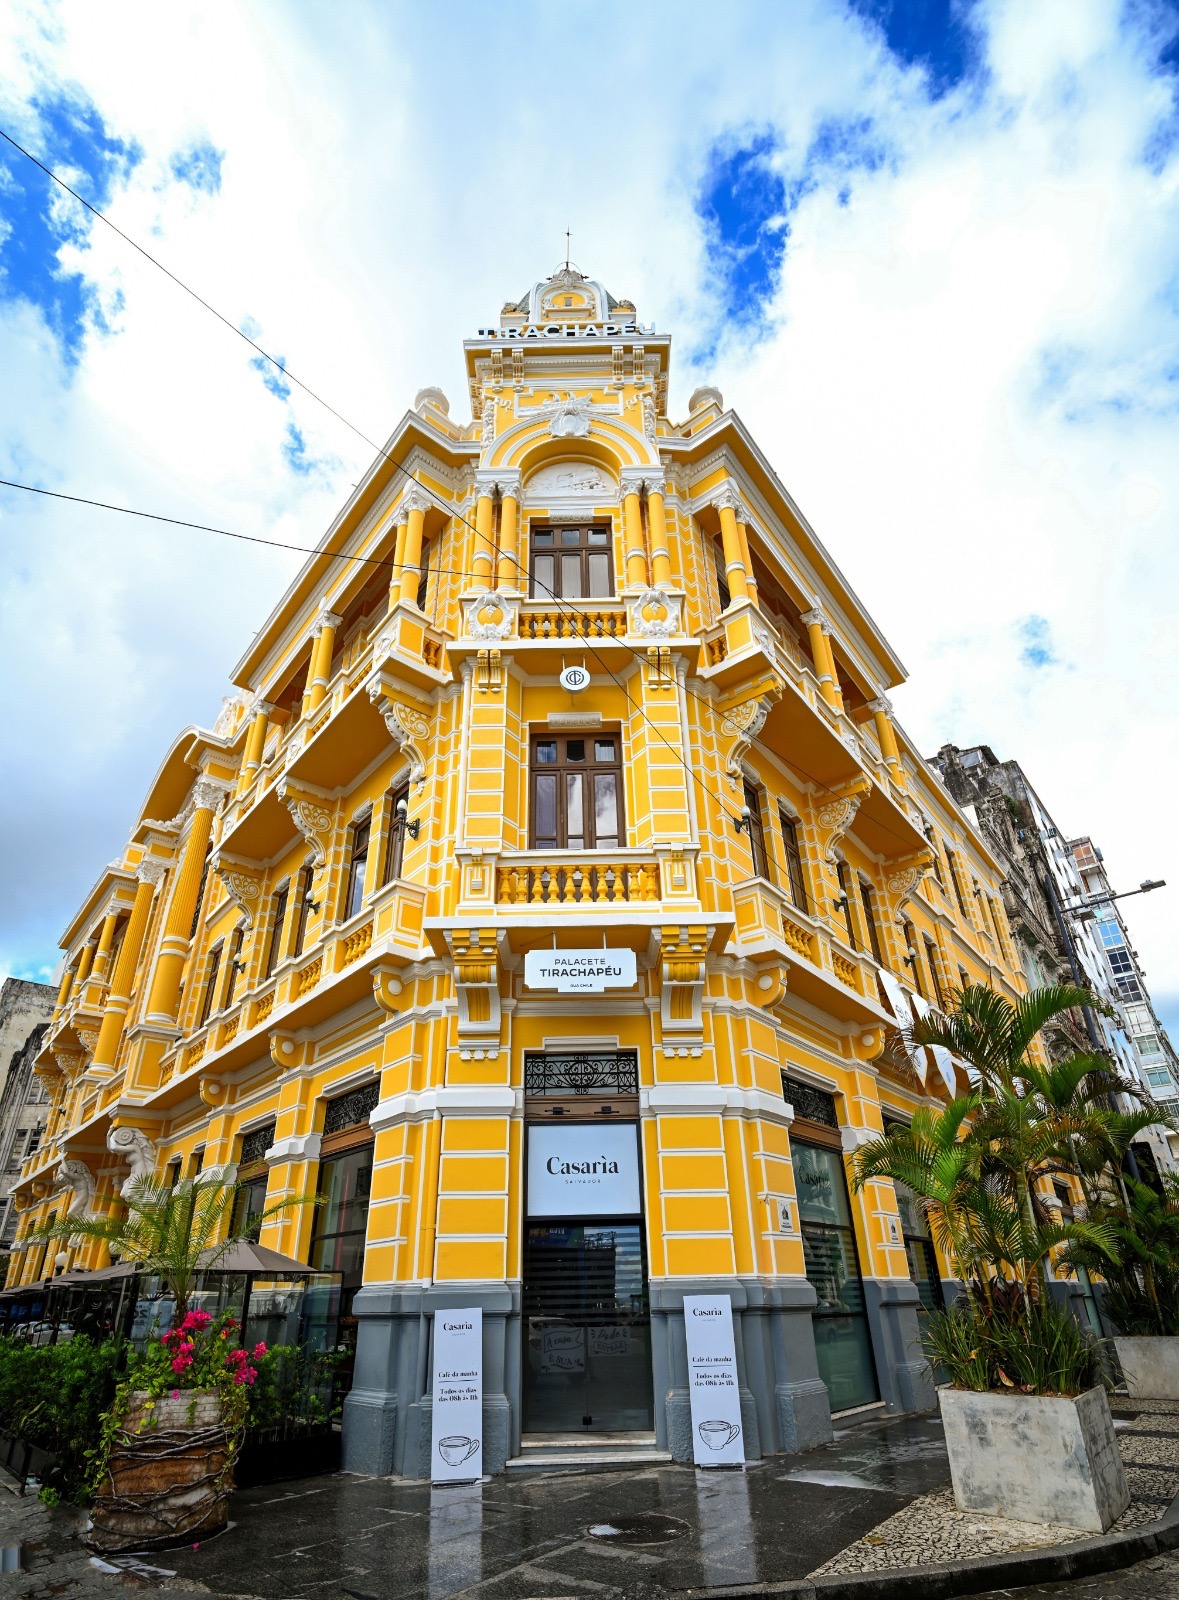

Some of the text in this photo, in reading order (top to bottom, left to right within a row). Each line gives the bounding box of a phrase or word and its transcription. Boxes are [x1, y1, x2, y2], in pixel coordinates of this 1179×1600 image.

[477, 320, 656, 339] TIRACHAPÉU
[554, 958, 606, 966] PALACETE
[539, 965, 622, 977] TIRACHAPÉU
